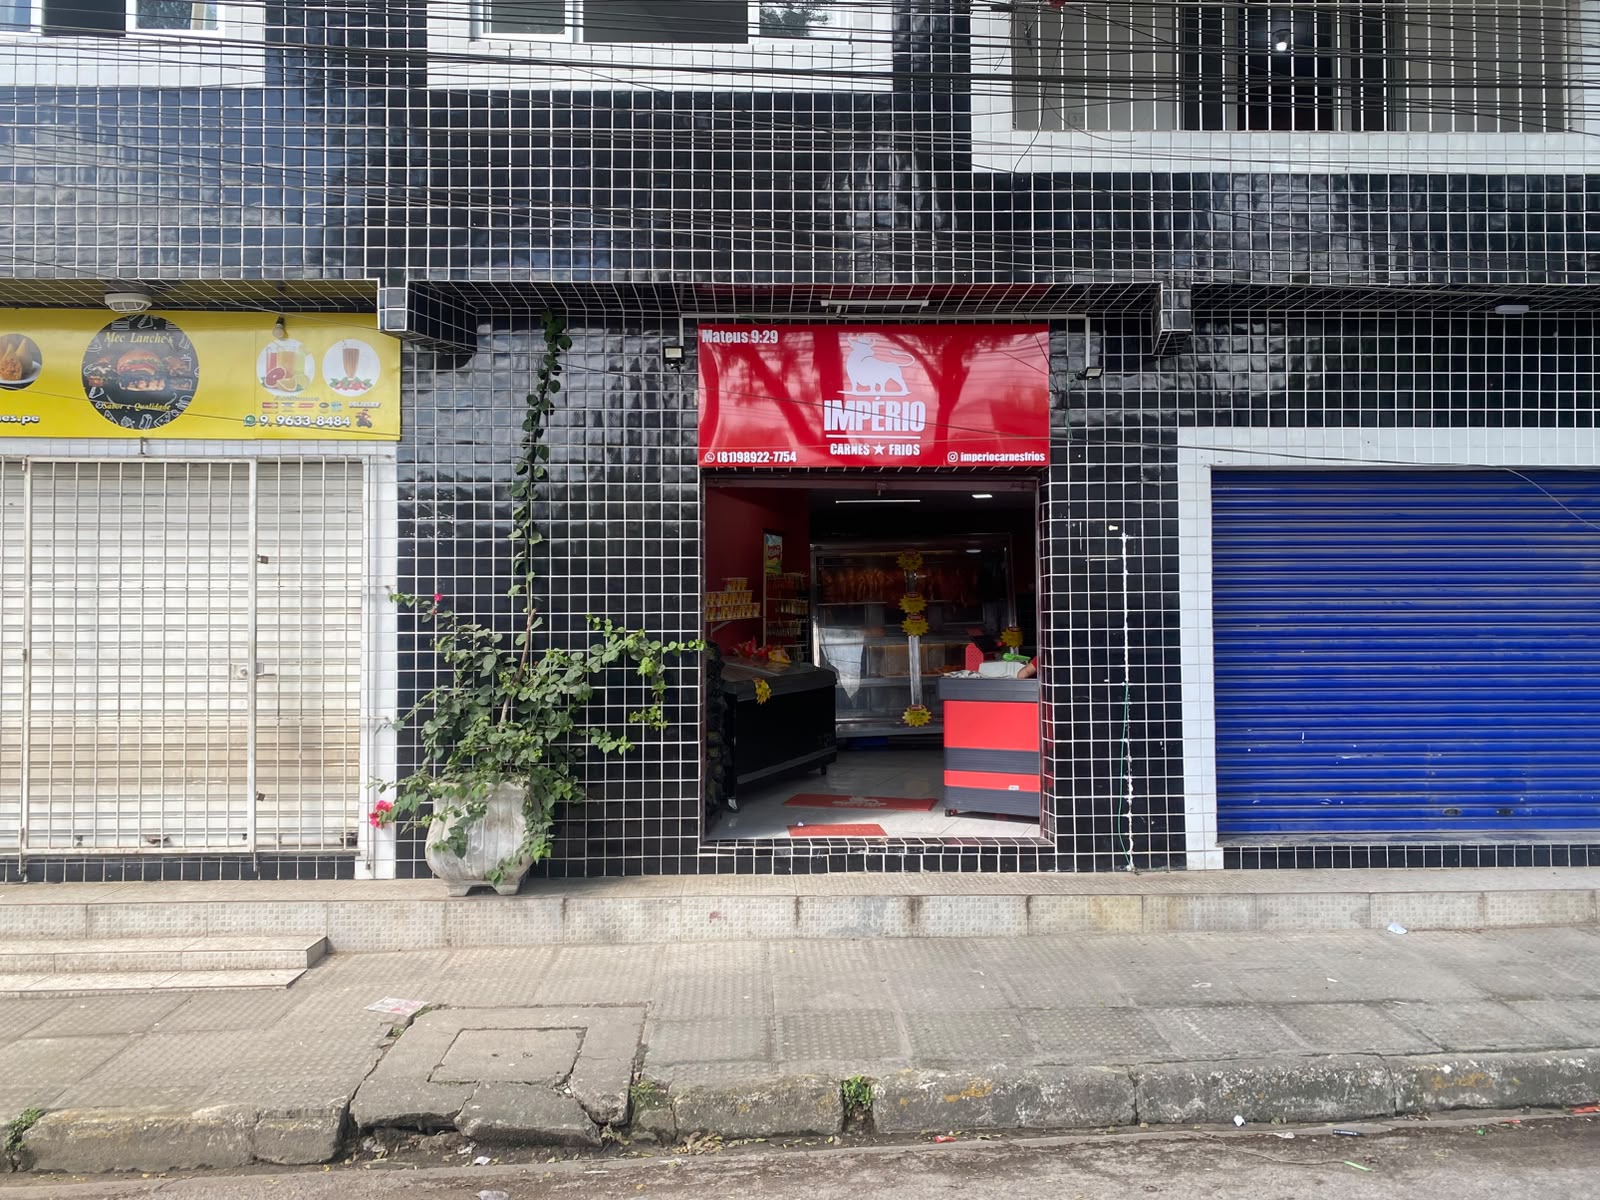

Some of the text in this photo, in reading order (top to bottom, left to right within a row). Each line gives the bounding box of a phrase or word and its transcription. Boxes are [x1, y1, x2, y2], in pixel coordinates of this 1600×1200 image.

[104, 331, 126, 345] Mec
[702, 329, 778, 344] Mateus 9:29
[0, 415, 40, 426] es.pe
[823, 396, 926, 432] IMPÉRIO
[276, 415, 351, 427] 9633-8484
[830, 443, 921, 456] CARNES FRIOS
[960, 451, 1046, 463] imperiocarnesfrios
